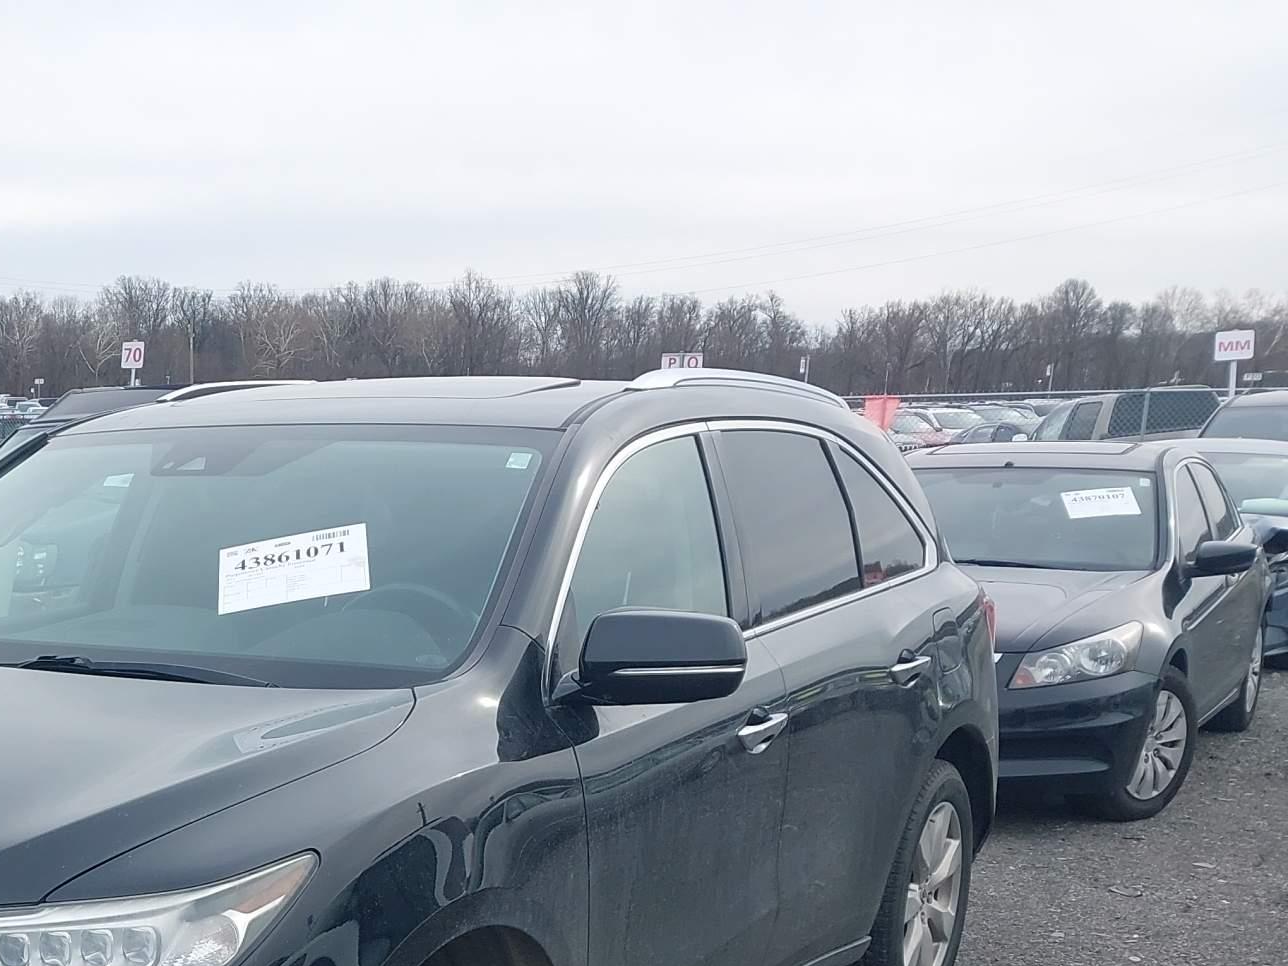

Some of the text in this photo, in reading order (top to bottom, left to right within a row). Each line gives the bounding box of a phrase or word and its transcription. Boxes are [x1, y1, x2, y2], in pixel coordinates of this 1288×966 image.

[1218, 339, 1251, 353] MM
[123, 347, 142, 363] 70
[668, 357, 677, 368] P
[234, 541, 346, 571] 43861071
